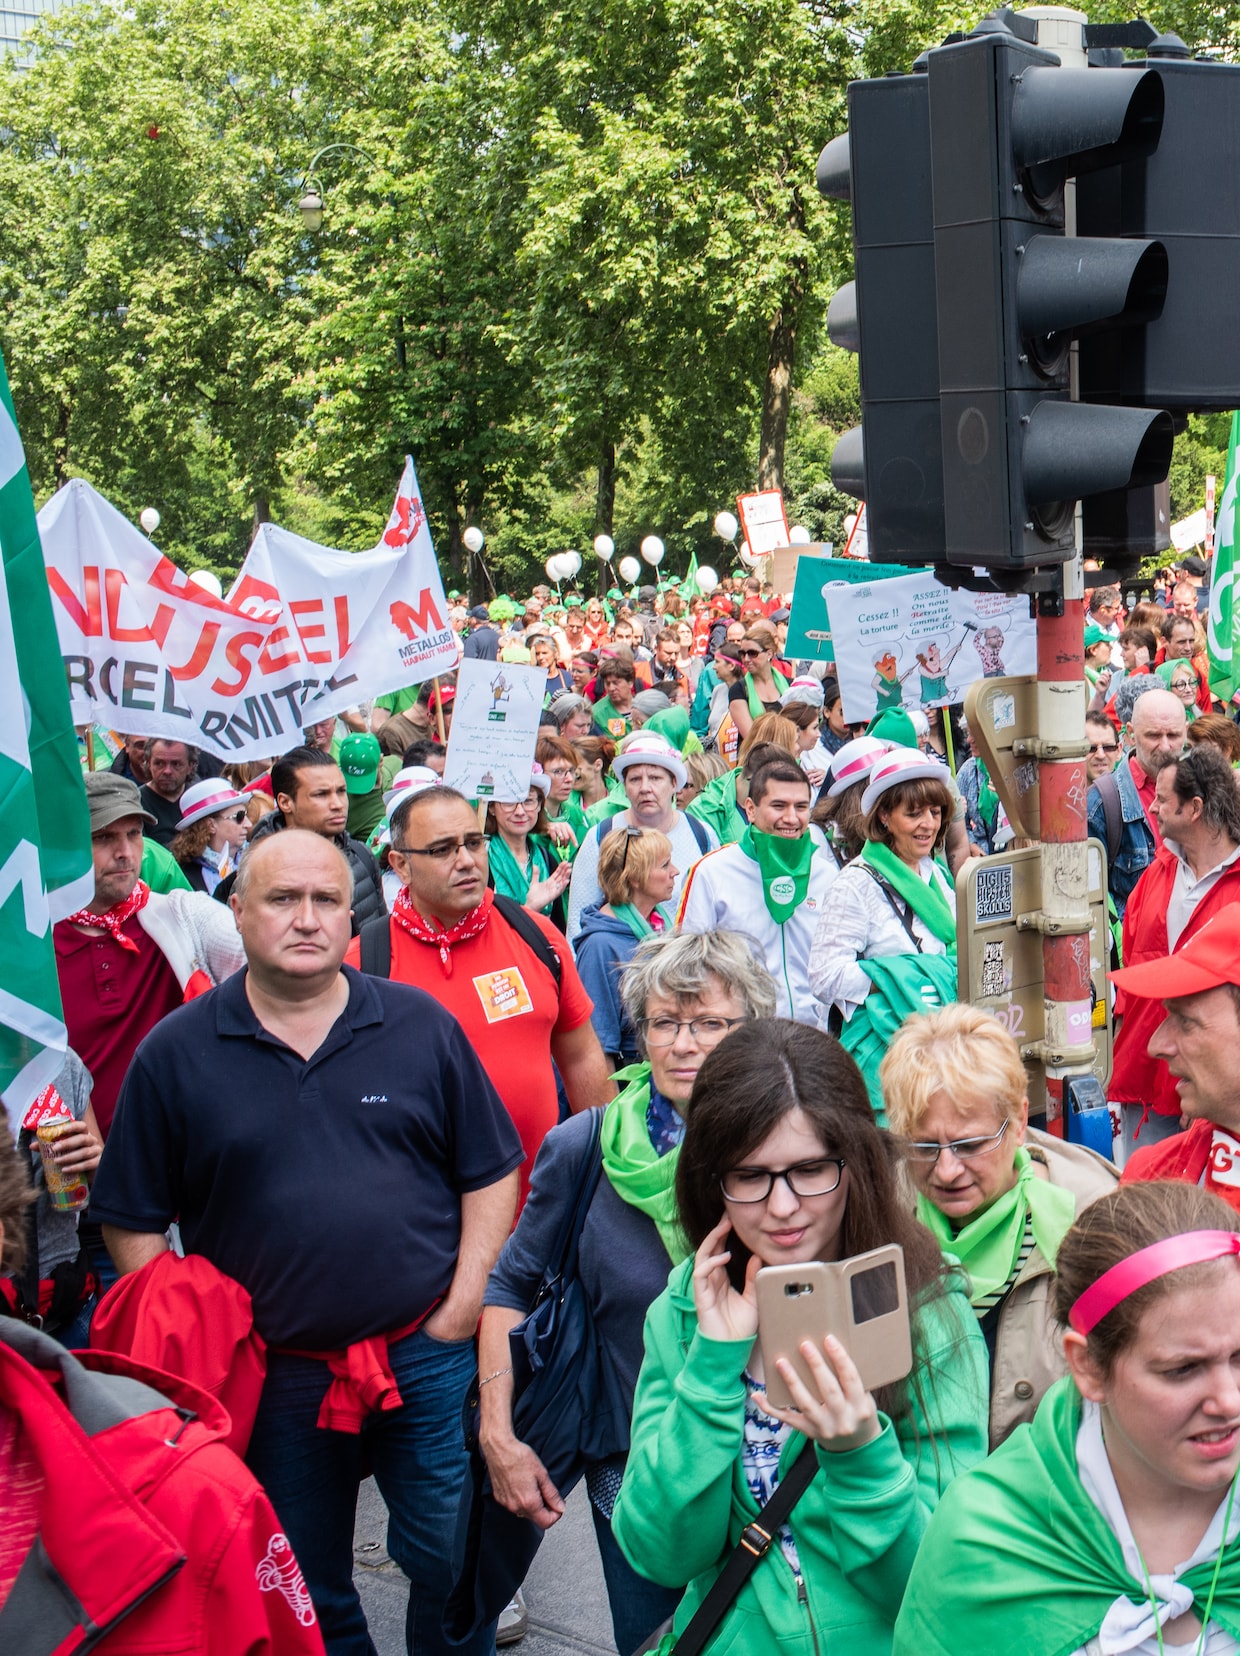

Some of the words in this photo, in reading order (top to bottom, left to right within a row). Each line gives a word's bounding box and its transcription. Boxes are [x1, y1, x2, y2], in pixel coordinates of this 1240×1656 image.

[912, 589, 941, 602] ASSEZ
[911, 602, 925, 611] On
[928, 599, 949, 607] nous
[858, 610, 890, 624] Cessez
[909, 617, 939, 627] comme
[942, 613, 952, 621] de
[910, 607, 949, 619] Retraite
[860, 626, 870, 636] La
[871, 622, 898, 634] torture
[911, 627, 920, 635] la
[923, 621, 949, 632] merde
[977, 899, 1011, 917] SKULLS
[494, 987, 516, 1005] DROIT
